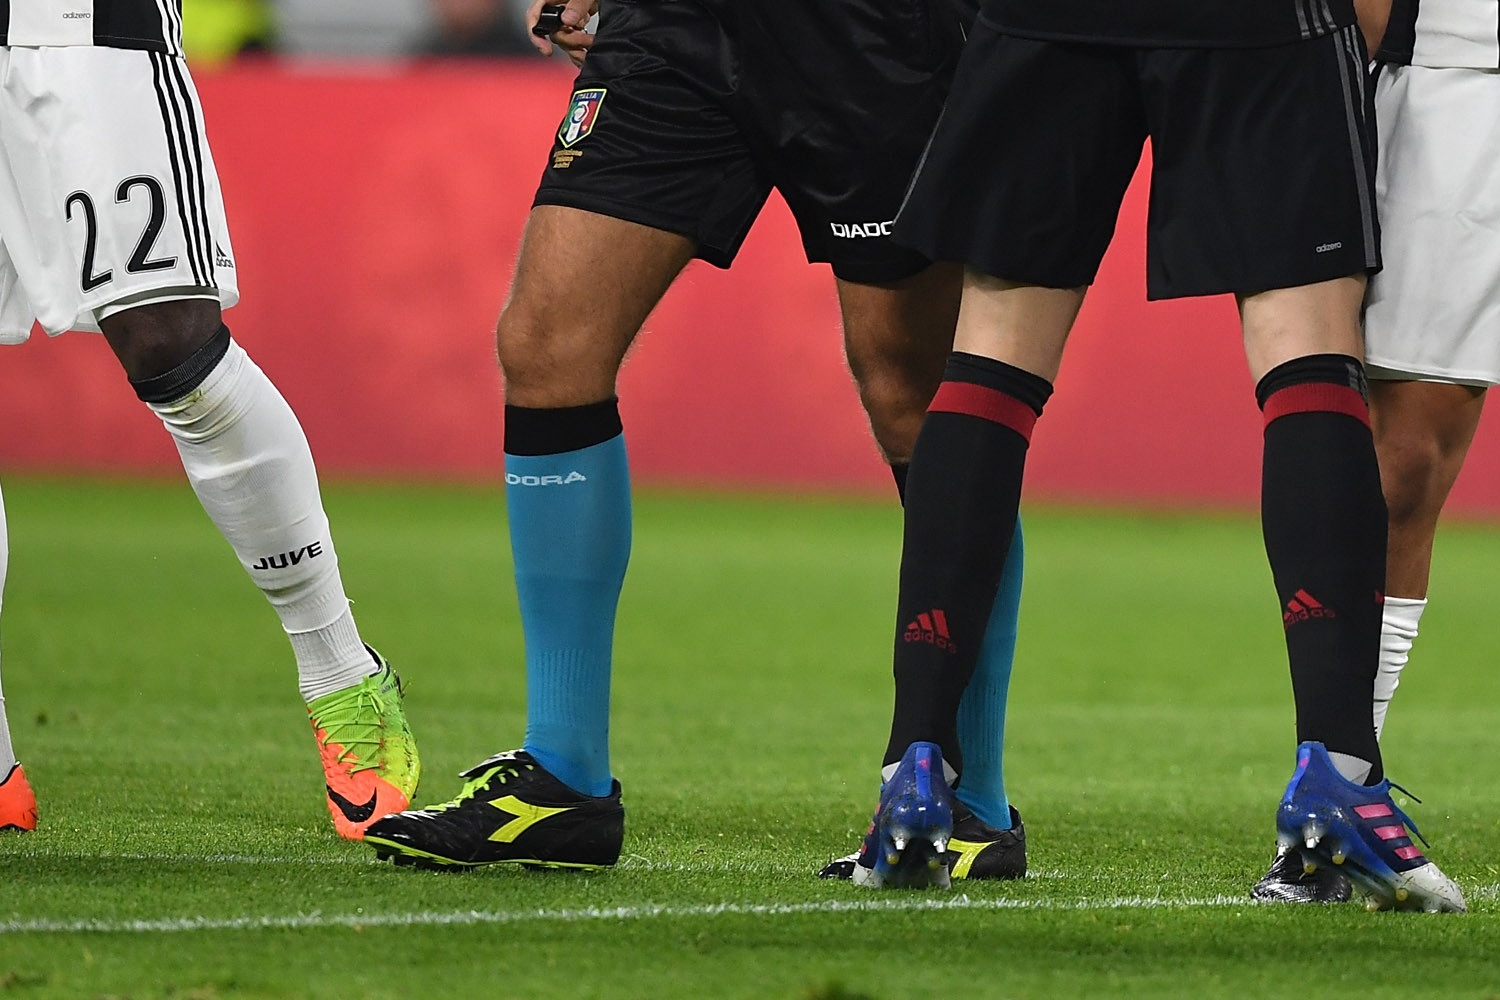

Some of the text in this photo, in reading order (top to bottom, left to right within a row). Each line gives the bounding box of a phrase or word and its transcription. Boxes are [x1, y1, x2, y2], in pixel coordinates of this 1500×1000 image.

[62, 11, 91, 19] adizero
[64, 174, 179, 294] 22
[252, 540, 323, 570] JUVE
[903, 629, 957, 656] adidas
